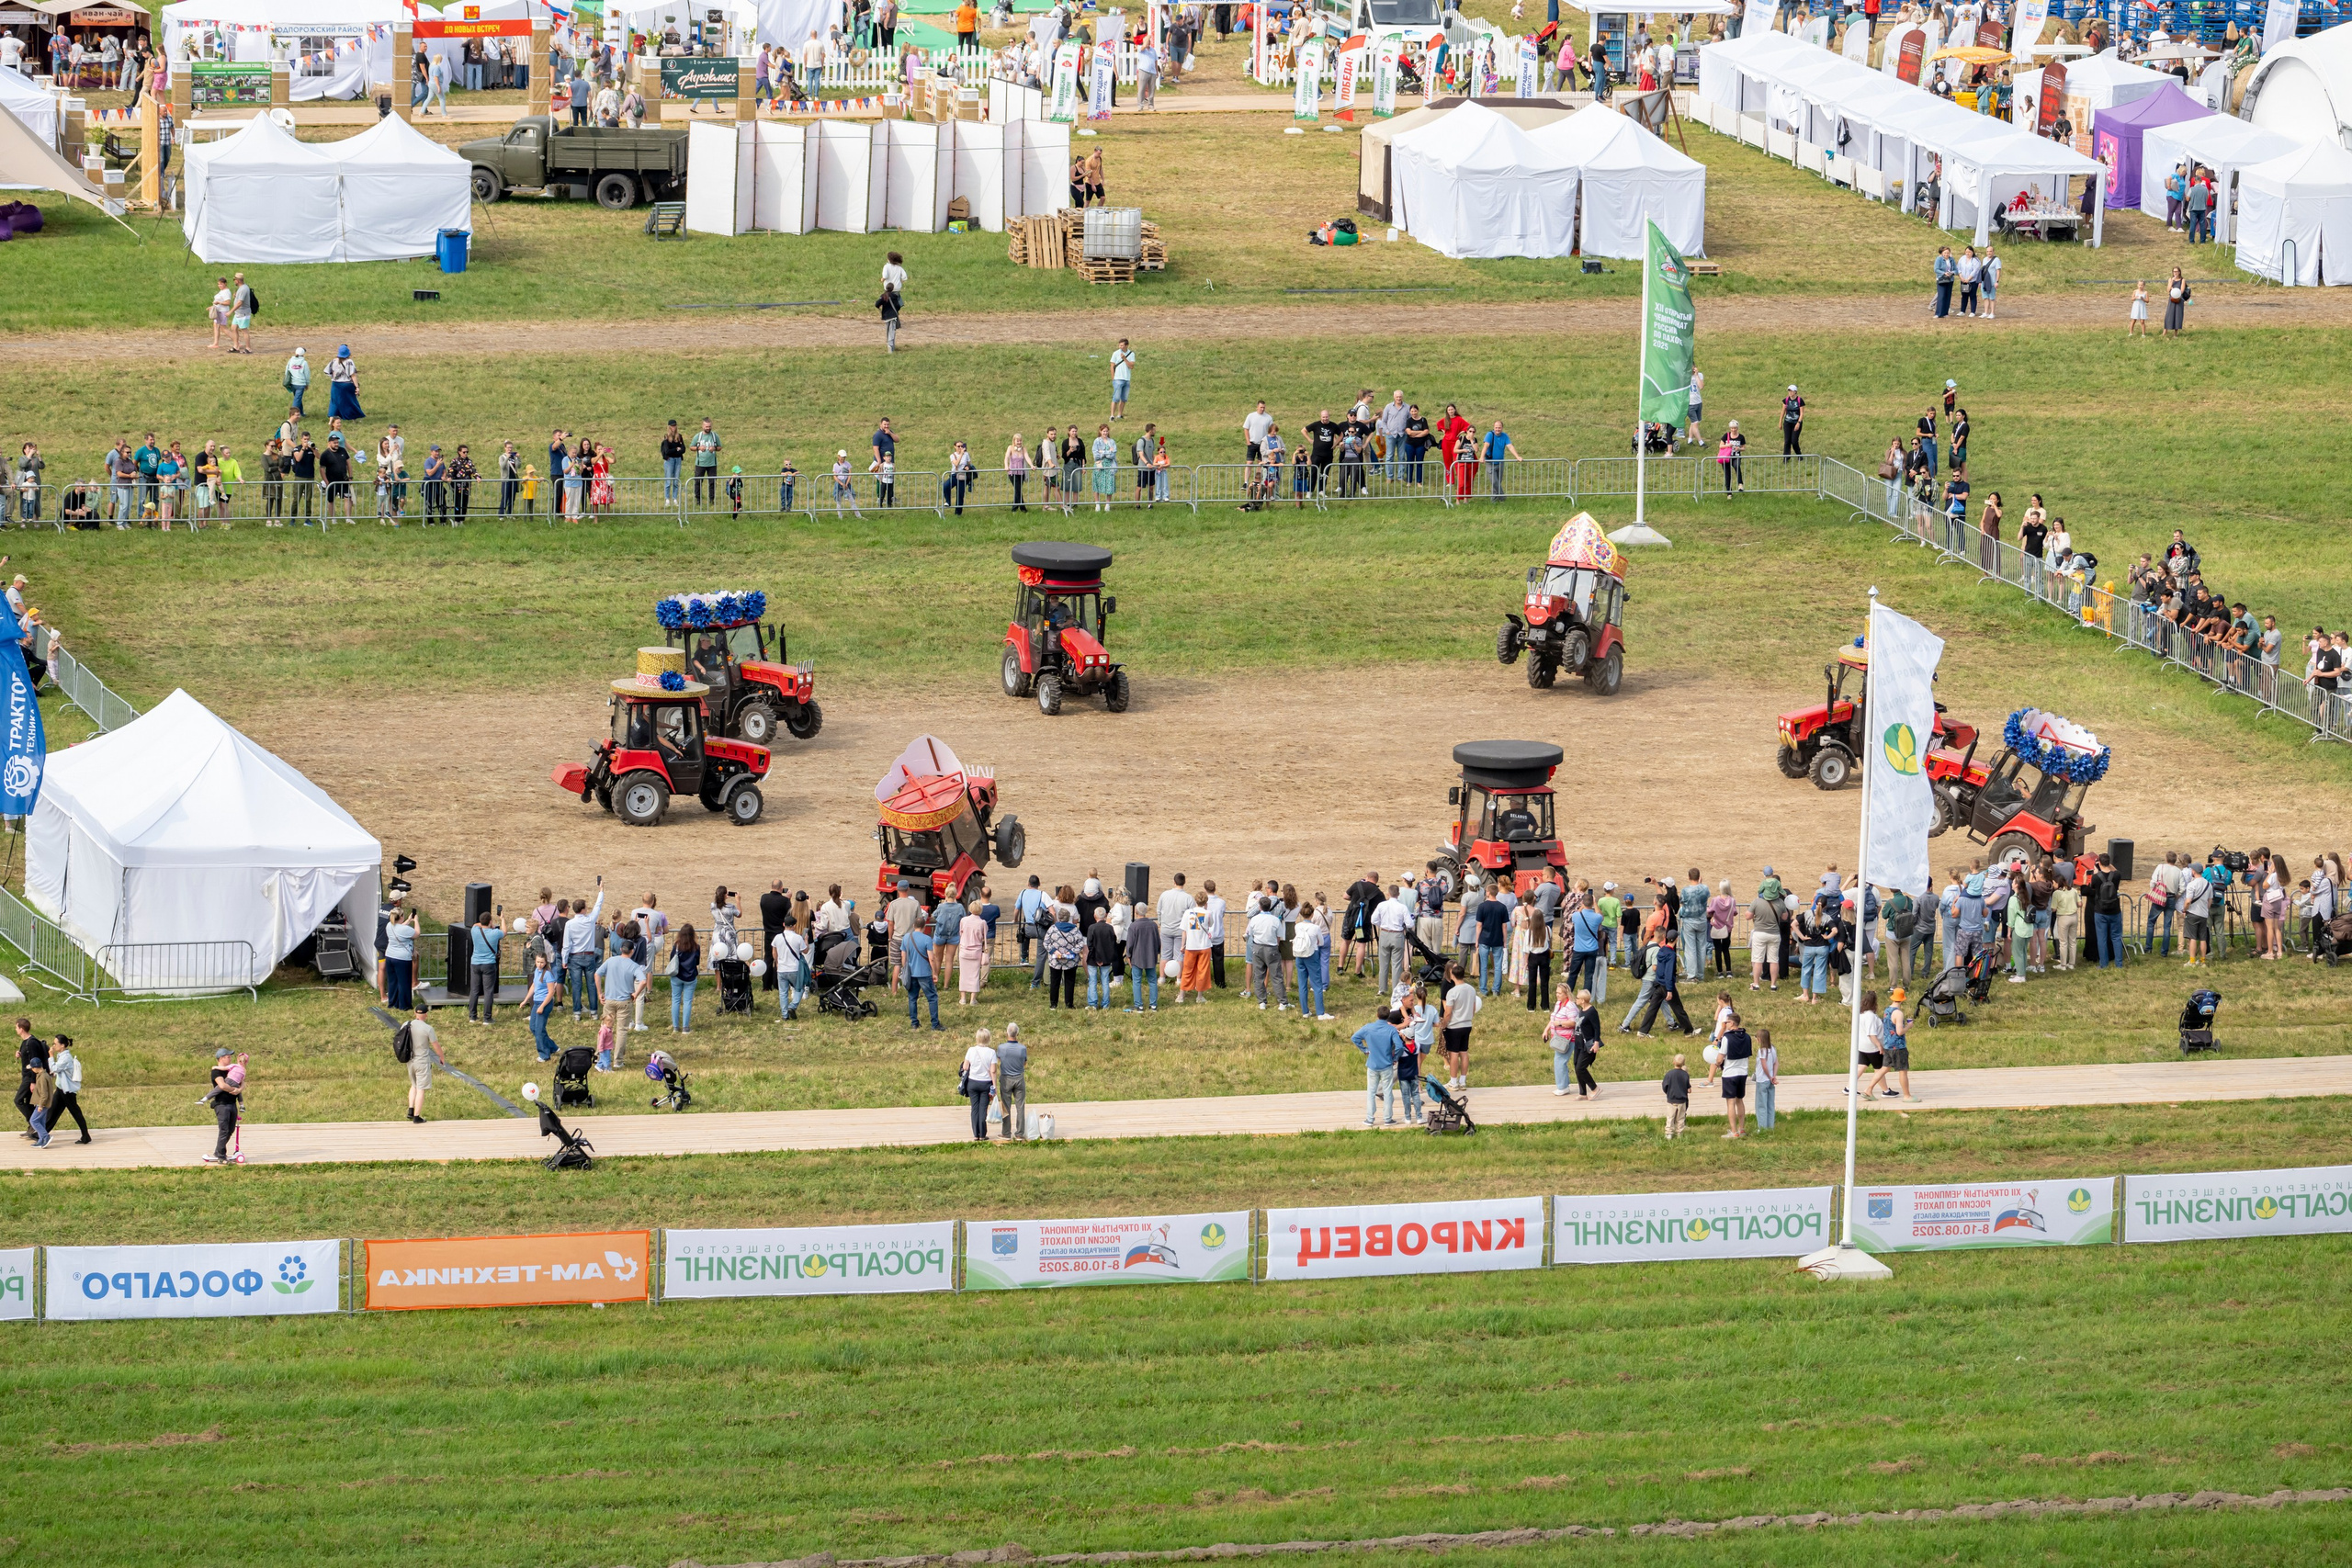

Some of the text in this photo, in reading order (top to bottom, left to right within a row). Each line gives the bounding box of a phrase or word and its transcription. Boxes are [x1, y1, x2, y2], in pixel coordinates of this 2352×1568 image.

[338, 25, 364, 33] РАЙОН
[444, 24, 501, 34] ДО НОВЫХ ВСТРЕЧ
[1104, 59, 1113, 67] 47
[1341, 56, 1354, 101] ПОБЕДА!
[1655, 302, 1664, 312] XII
[1653, 339, 1668, 351] 2025
